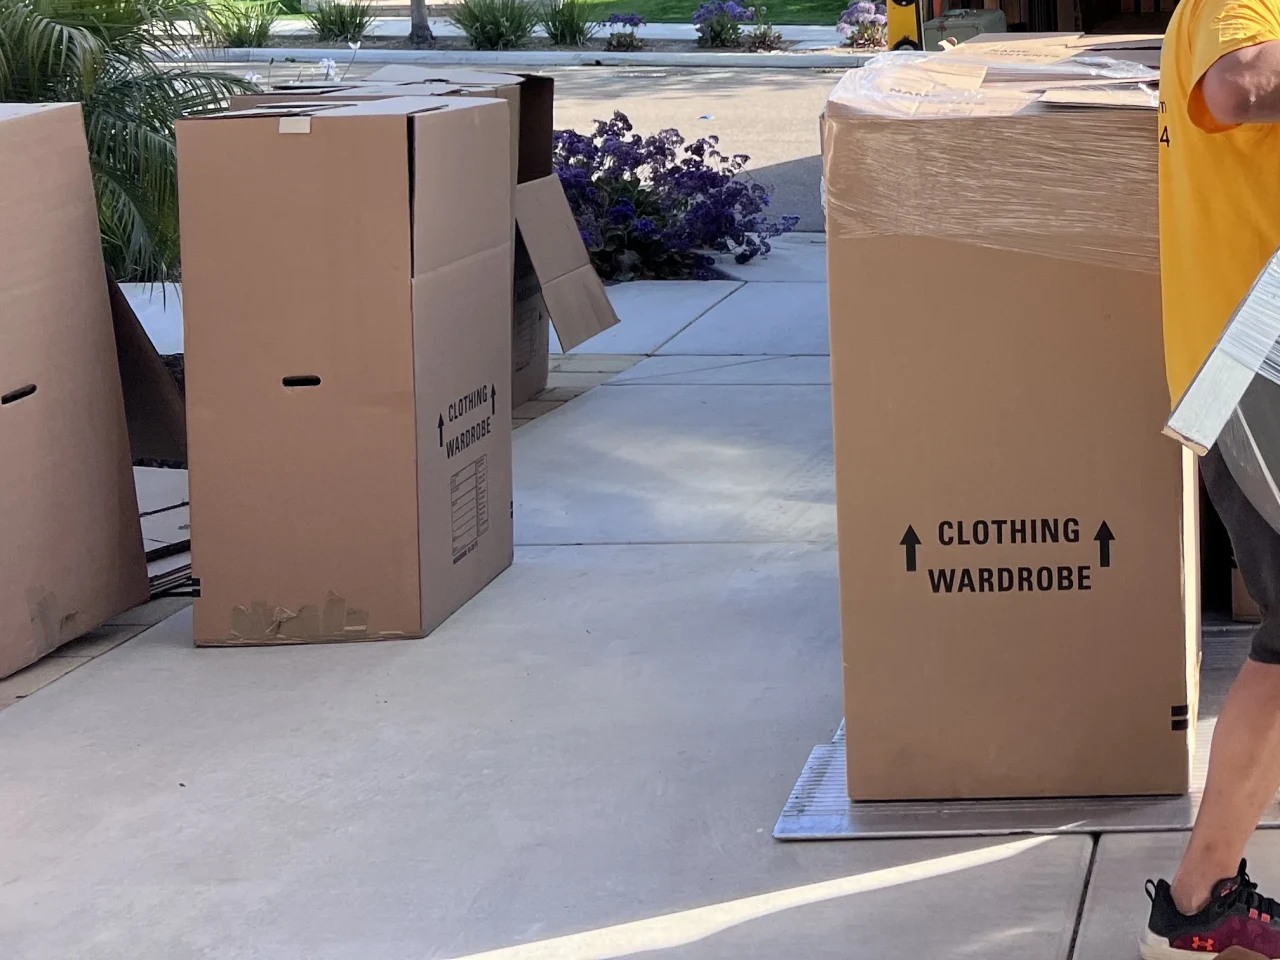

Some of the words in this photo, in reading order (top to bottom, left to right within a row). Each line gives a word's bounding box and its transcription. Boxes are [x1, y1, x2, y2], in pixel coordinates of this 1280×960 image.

[1159, 125, 1170, 148] 4
[448, 384, 488, 423] CLOTHING
[446, 416, 491, 459] WARDROBE
[938, 517, 1080, 546] CLOTHING
[928, 565, 1092, 594] WARDROBE
